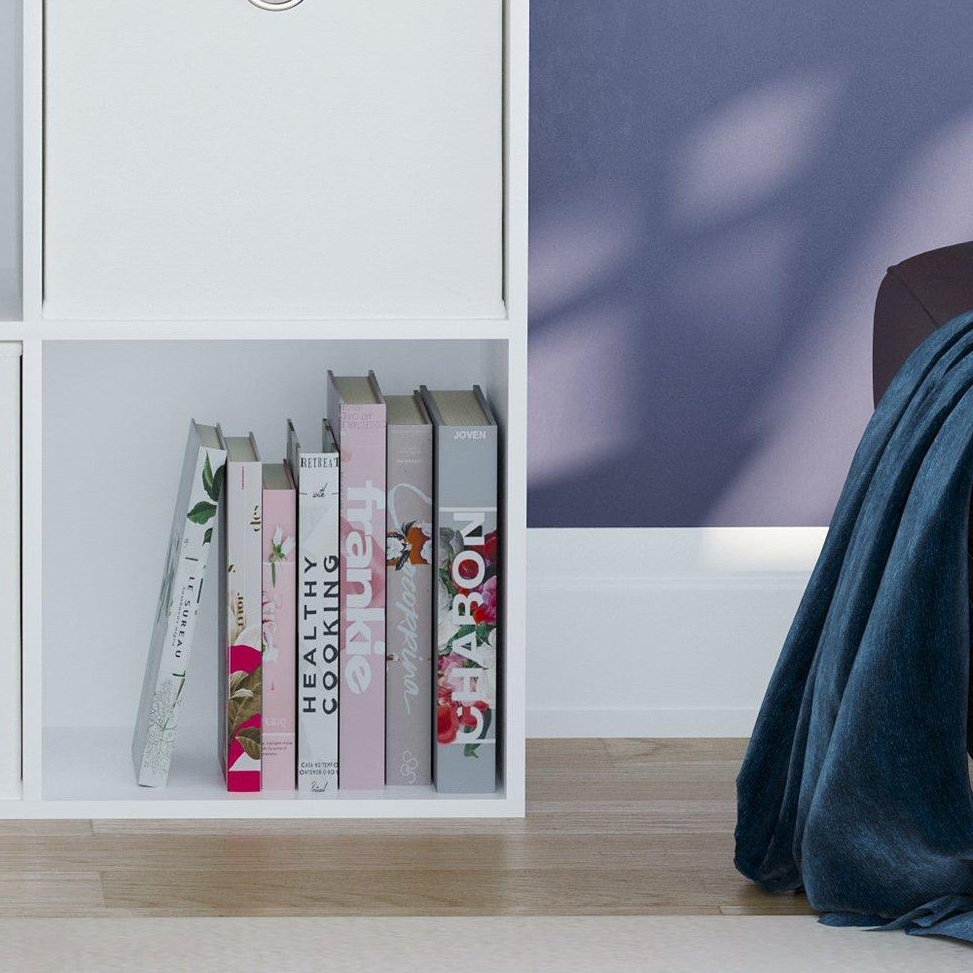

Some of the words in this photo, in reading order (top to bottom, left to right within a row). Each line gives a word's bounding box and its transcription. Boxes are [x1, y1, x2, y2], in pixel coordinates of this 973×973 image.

[300, 456, 339, 469] RETREAT
[453, 430, 487, 441] JOVEN
[174, 600, 191, 658] SUREAU
[187, 576, 196, 592] LE
[302, 555, 318, 714] HEALTHY
[322, 554, 339, 716] COOKING
[344, 479, 387, 695] frankie
[450, 512, 487, 742] CHABON
